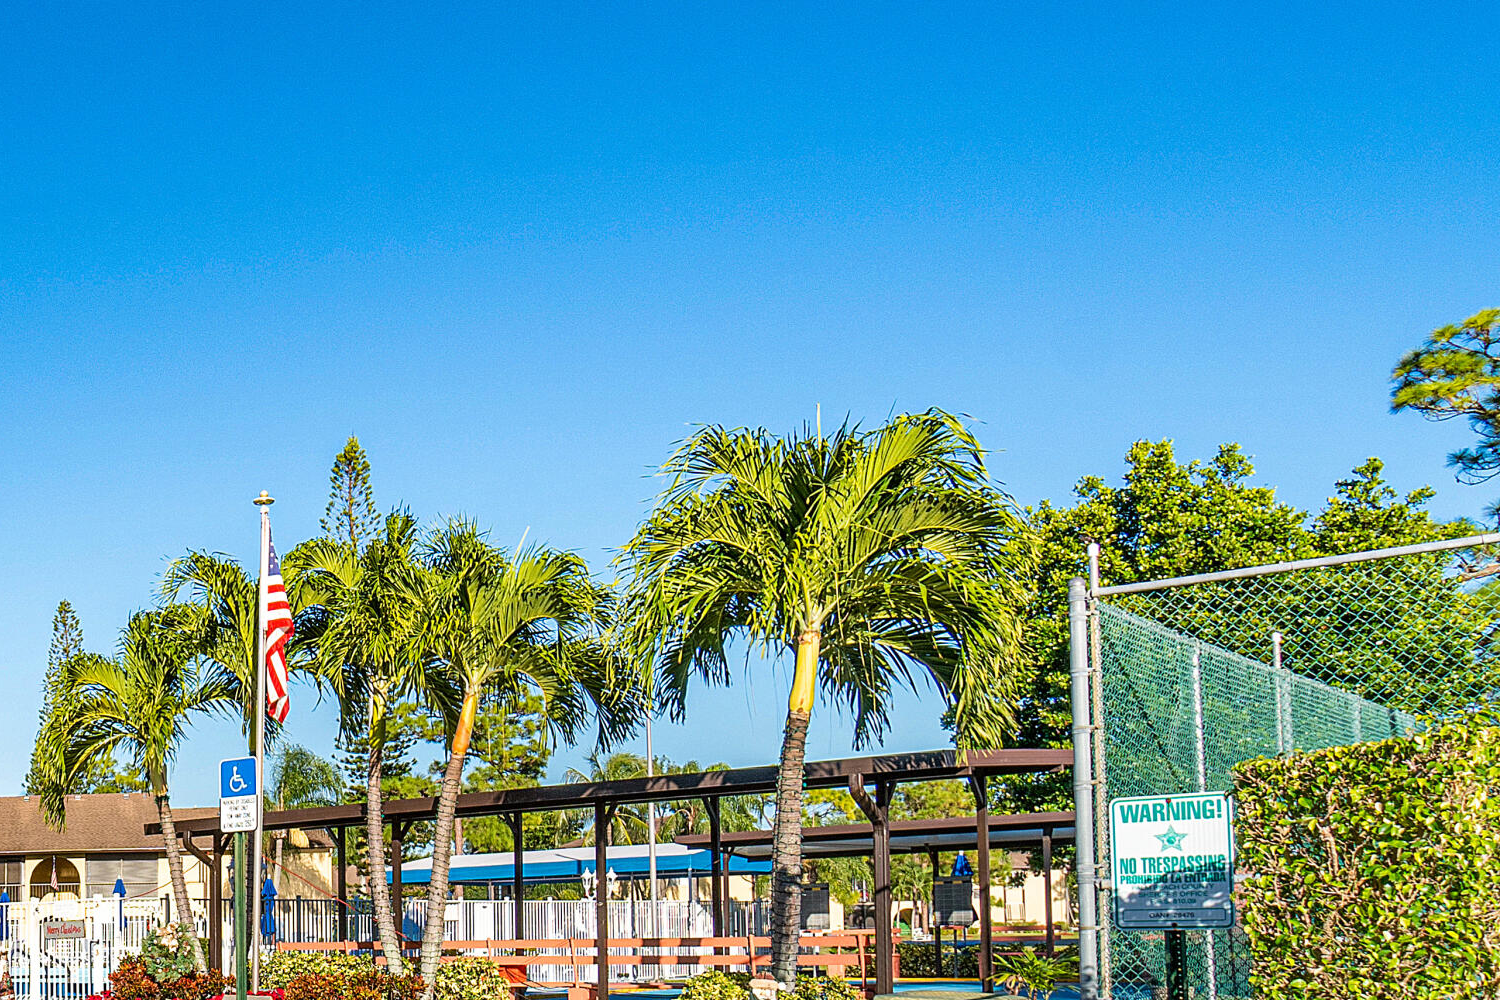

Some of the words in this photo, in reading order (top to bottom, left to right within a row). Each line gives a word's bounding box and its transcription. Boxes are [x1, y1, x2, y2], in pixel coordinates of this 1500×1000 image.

[1120, 799, 1222, 823] WARNING!
[1120, 857, 1137, 875] NO
[1141, 854, 1226, 874] TRESPASSING
[1120, 874, 1168, 884] PROHIBIDO
[1171, 874, 1182, 884] LA
[1184, 872, 1226, 883] ENTRADA
[46, 925, 60, 936] Merry
